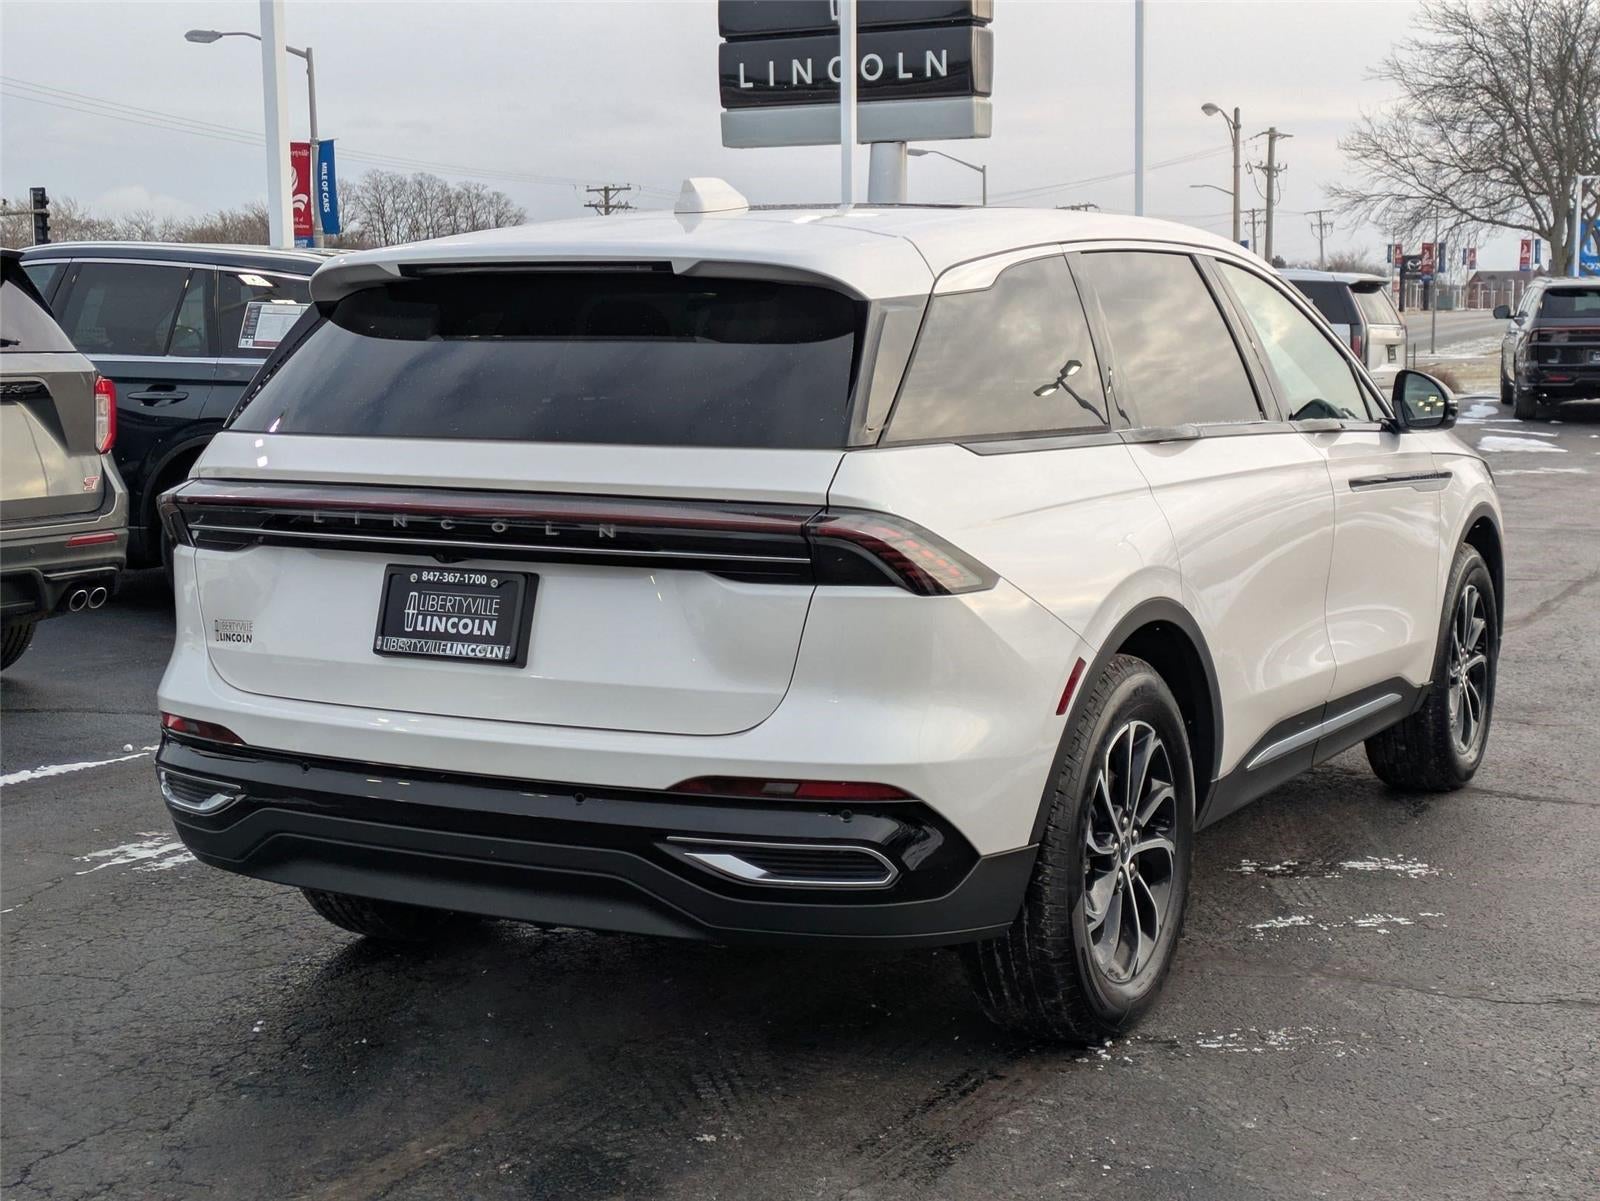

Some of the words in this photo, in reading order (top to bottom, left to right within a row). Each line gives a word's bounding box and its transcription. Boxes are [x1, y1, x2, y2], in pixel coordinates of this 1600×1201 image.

[739, 49, 948, 88] LINCOLN
[321, 181, 328, 191] OF
[322, 192, 331, 213] CARS
[313, 512, 616, 538] LINCOLN
[422, 571, 487, 585] 847-367-1700
[419, 594, 501, 616] LIBERTYVILLE
[416, 615, 497, 636] LINCOLN
[219, 632, 254, 643] LINCOLN
